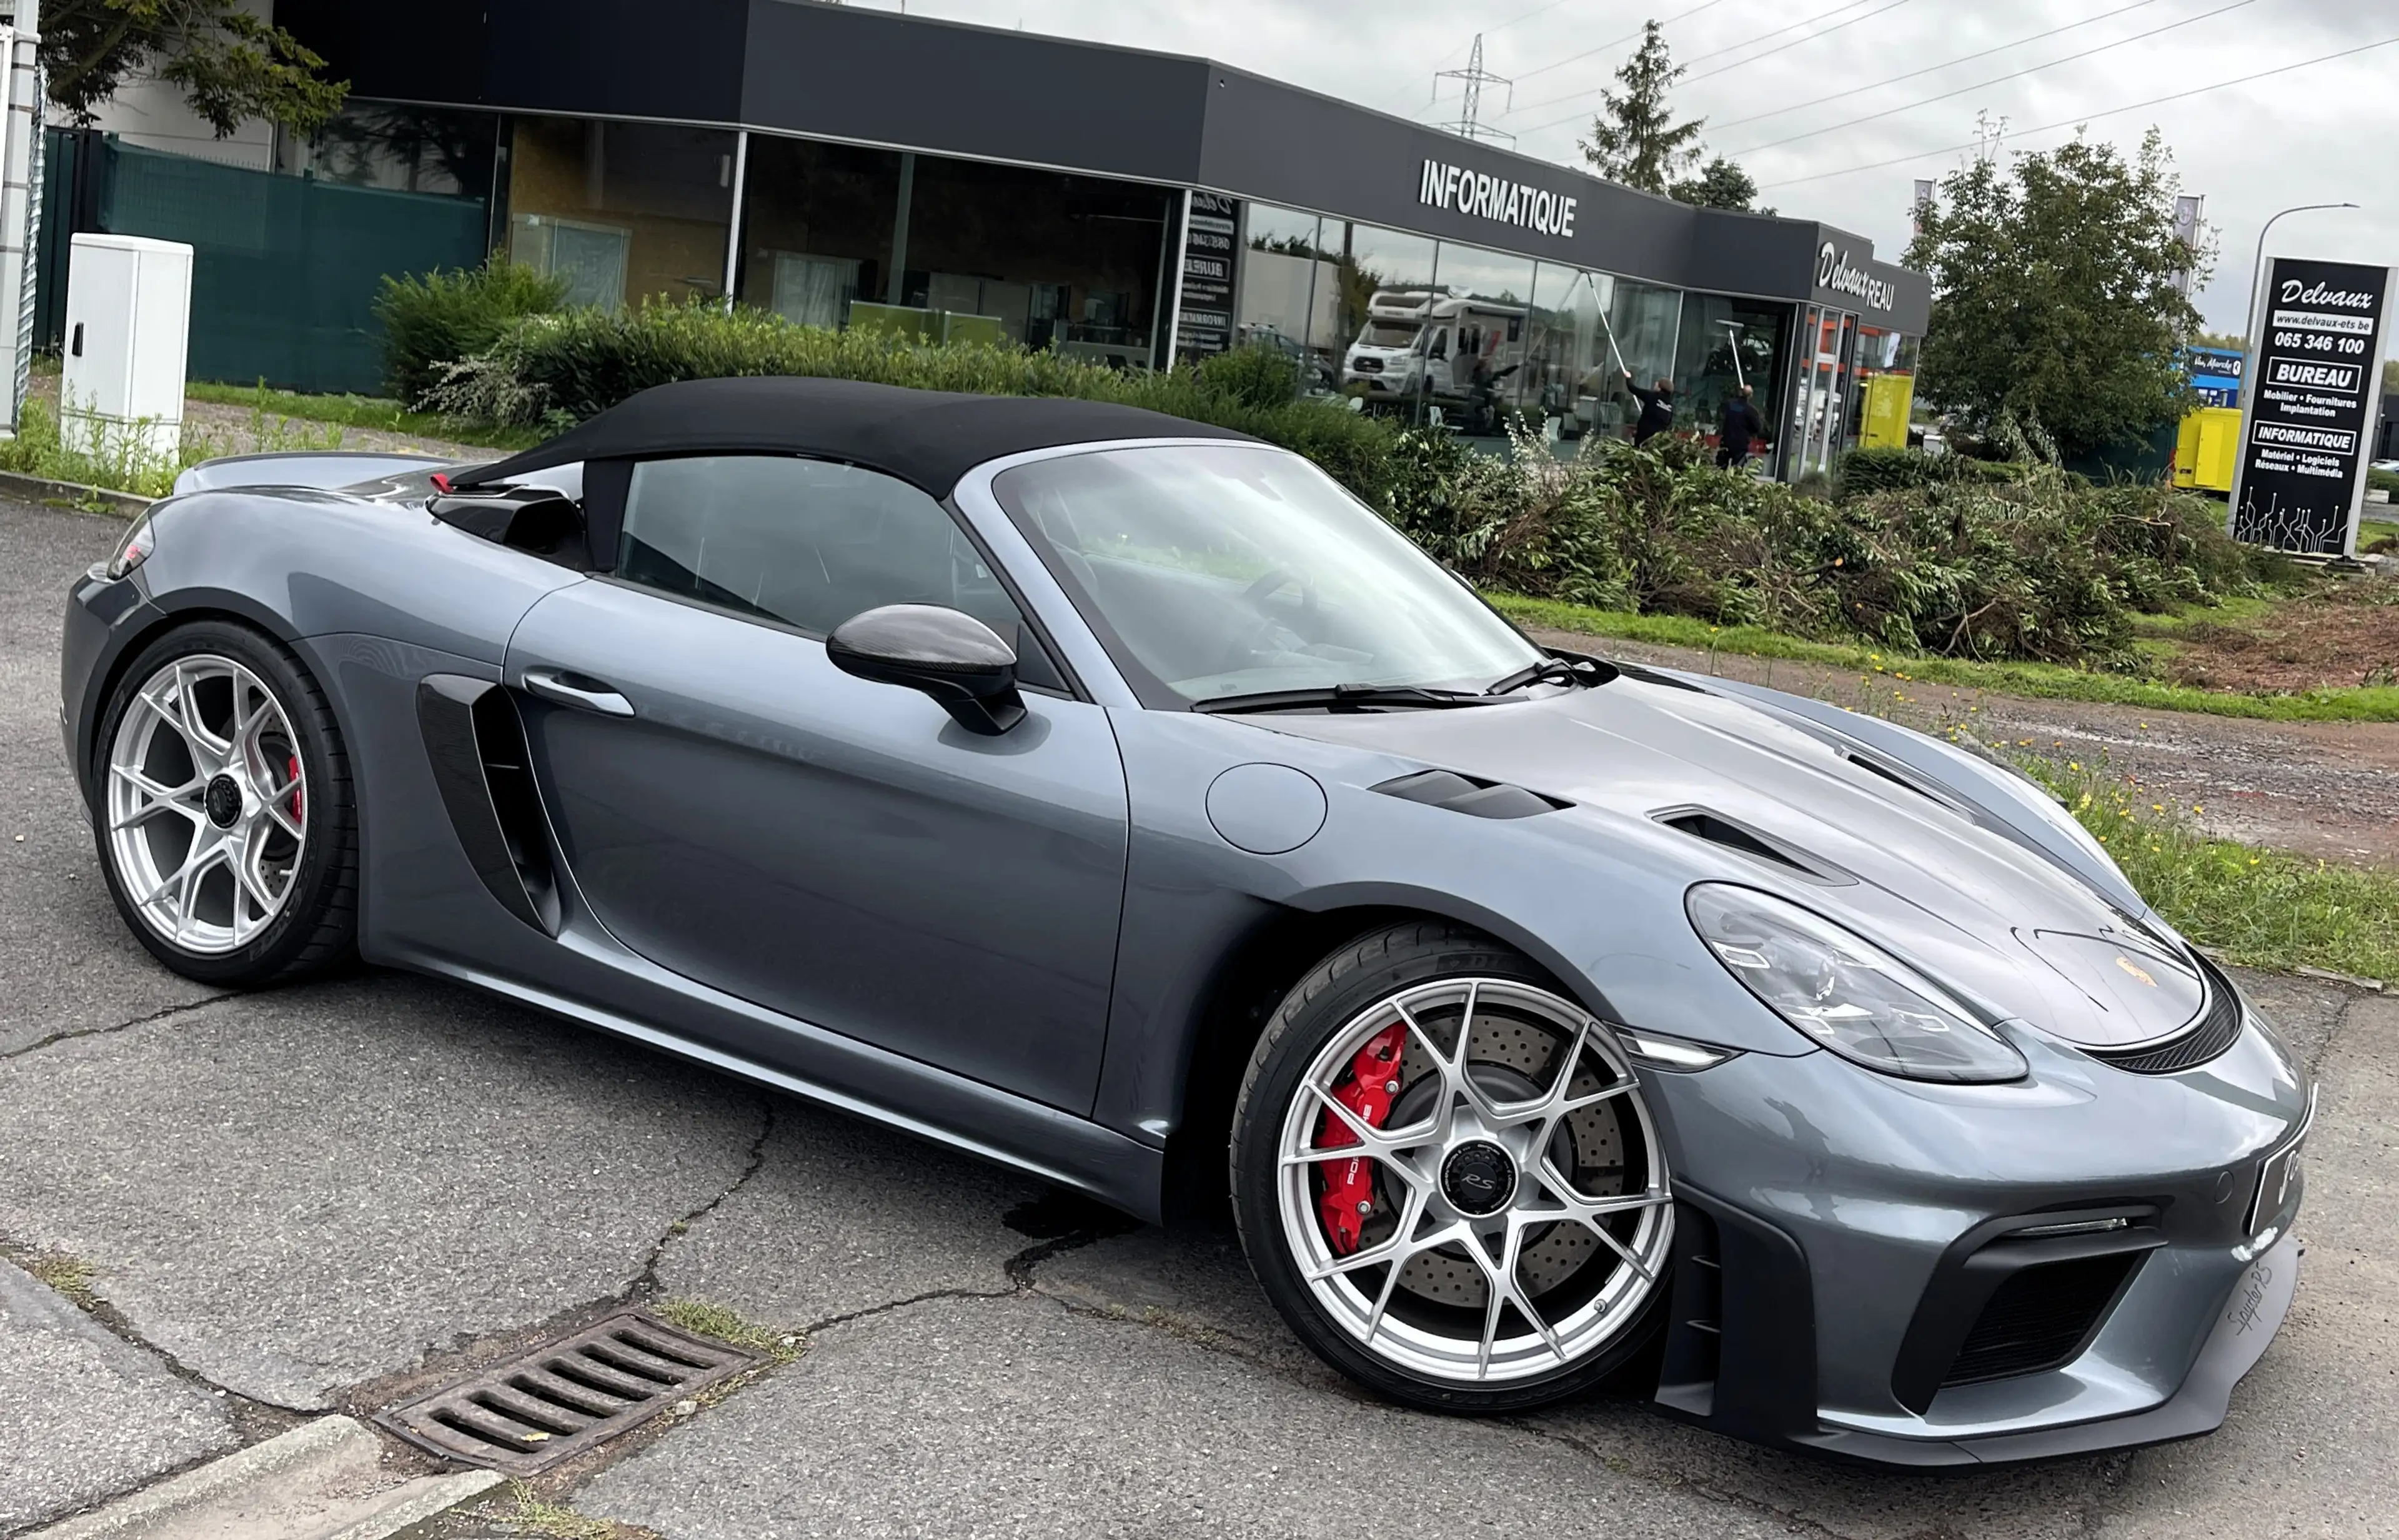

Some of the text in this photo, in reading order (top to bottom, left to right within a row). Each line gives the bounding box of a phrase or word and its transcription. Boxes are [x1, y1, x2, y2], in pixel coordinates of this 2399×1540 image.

[1419, 159, 1577, 237] INFORMATIQUE
[1819, 241, 1870, 298] Delvaux
[1867, 279, 1894, 312] REAU
[2282, 279, 2373, 309] Delvaux
[2277, 315, 2370, 331] www.delvaux-etsbe
[2275, 332, 2365, 354] 065 346 100
[2276, 364, 2353, 387] BUREAU
[2263, 389, 2357, 409] Mobilier Fournitures
[2280, 402, 2336, 417] Implantation
[2258, 426, 2351, 449] INFORMATIQUE
[2255, 459, 2343, 479] Réseaux Multimédia
[2261, 449, 2340, 467] Matériel Logiciels
[1461, 1173, 1496, 1190] RS
[2227, 1261, 2272, 1336] Spyder RS
